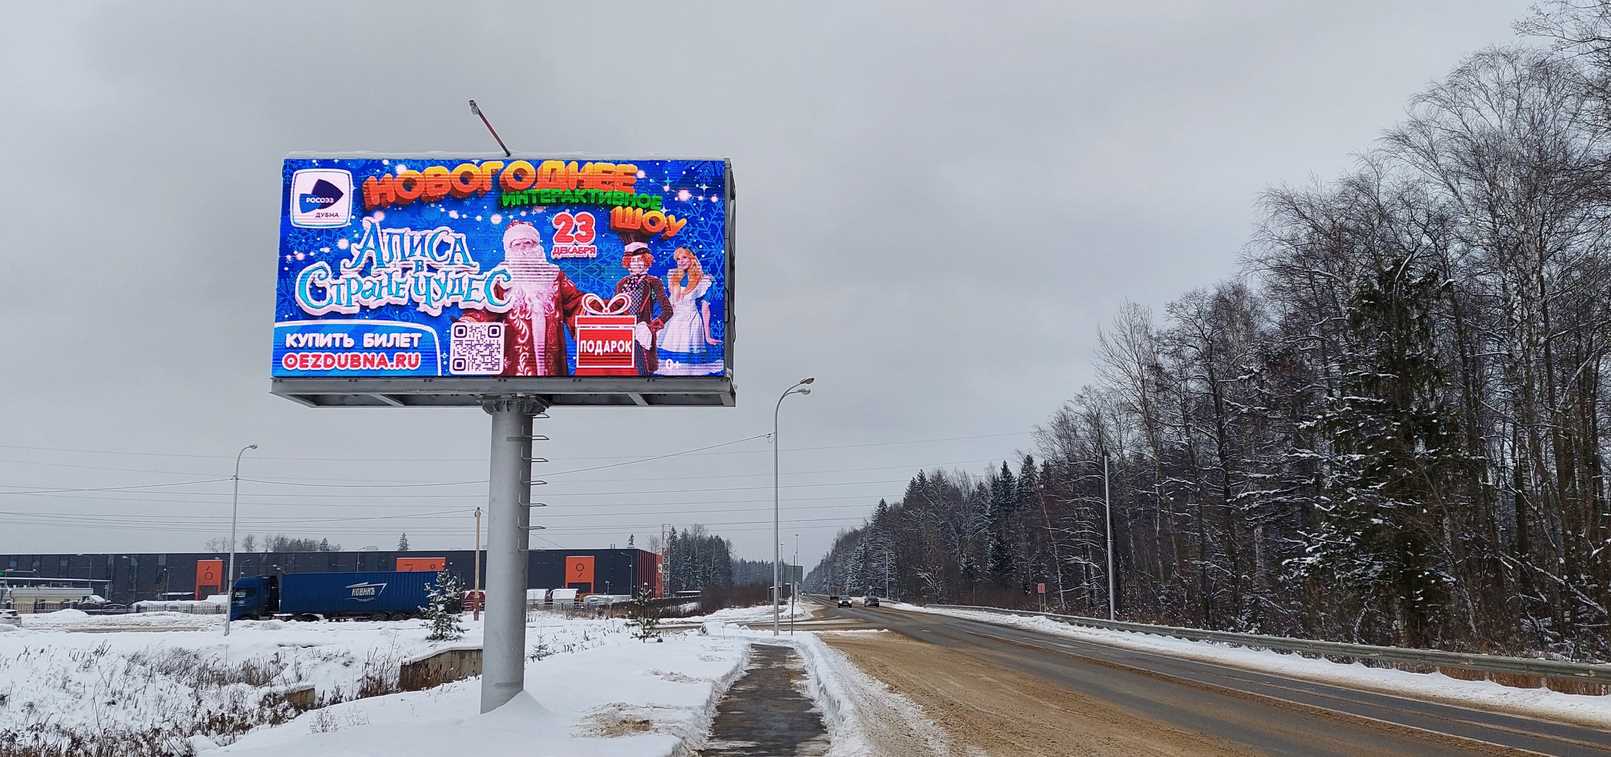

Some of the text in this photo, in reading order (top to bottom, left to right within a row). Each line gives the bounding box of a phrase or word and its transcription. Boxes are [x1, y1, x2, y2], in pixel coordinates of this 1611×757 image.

[363, 160, 638, 209] НОВОГОДНЕЕ
[502, 188, 662, 211] ИНТЕРАКТИВНОЕ
[552, 212, 596, 244] 23
[610, 206, 687, 239] ШОУ
[552, 246, 597, 257] ДЕКАБРЯ
[285, 333, 422, 348] КУПИТЬ БИЛЕТ
[580, 340, 632, 355] ПОДАРОК
[282, 353, 421, 370] OEZDUBNA.RU
[665, 358, 681, 369] 0+
